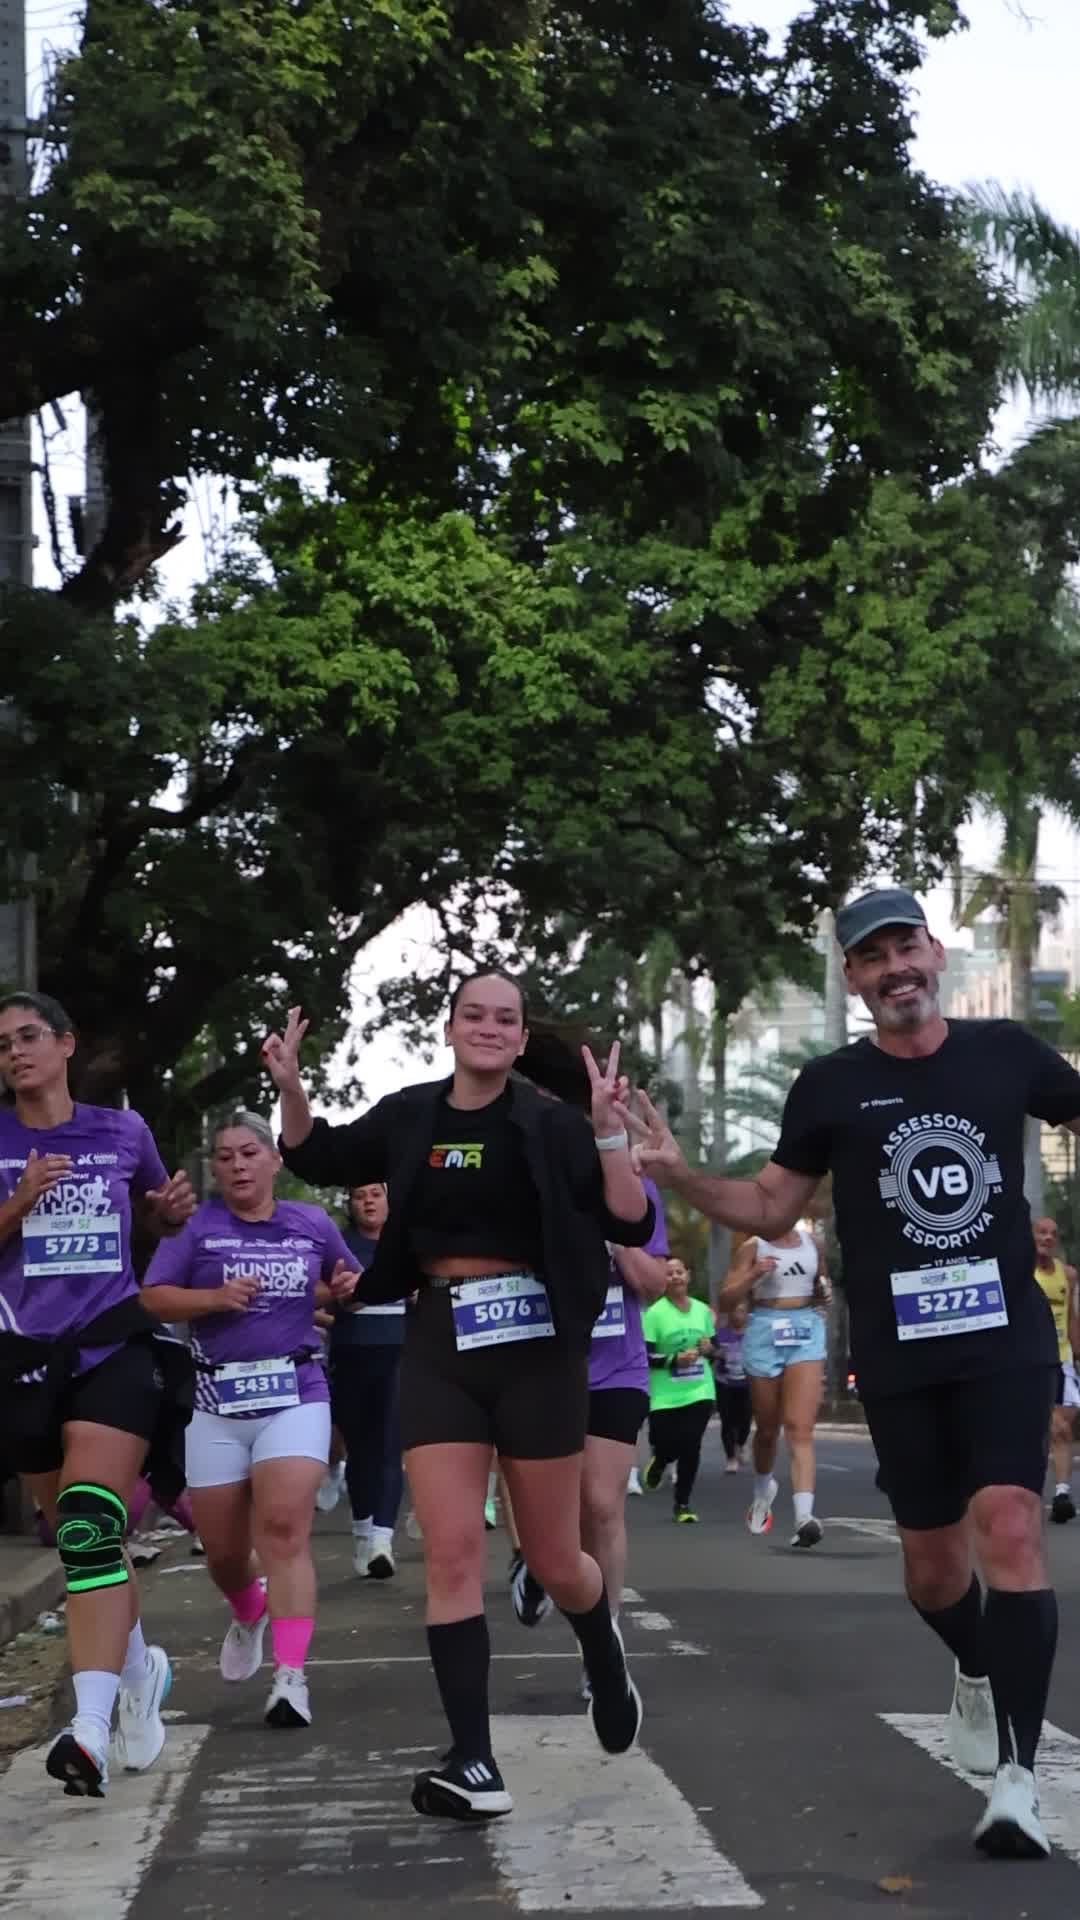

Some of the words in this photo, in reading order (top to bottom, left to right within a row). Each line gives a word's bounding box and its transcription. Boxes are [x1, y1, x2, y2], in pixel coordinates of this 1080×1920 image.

[882, 1113, 986, 1157] ASSESSORIA
[429, 1150, 482, 1168] EMA
[912, 1164, 968, 1198] V8
[902, 1211, 994, 1249] ESPORTIVA
[45, 1235, 99, 1255] 5773
[946, 1256, 969, 1265] ANOS
[474, 1298, 531, 1324] 5076
[917, 1288, 980, 1314] 5272
[234, 1375, 279, 1395] 5431
